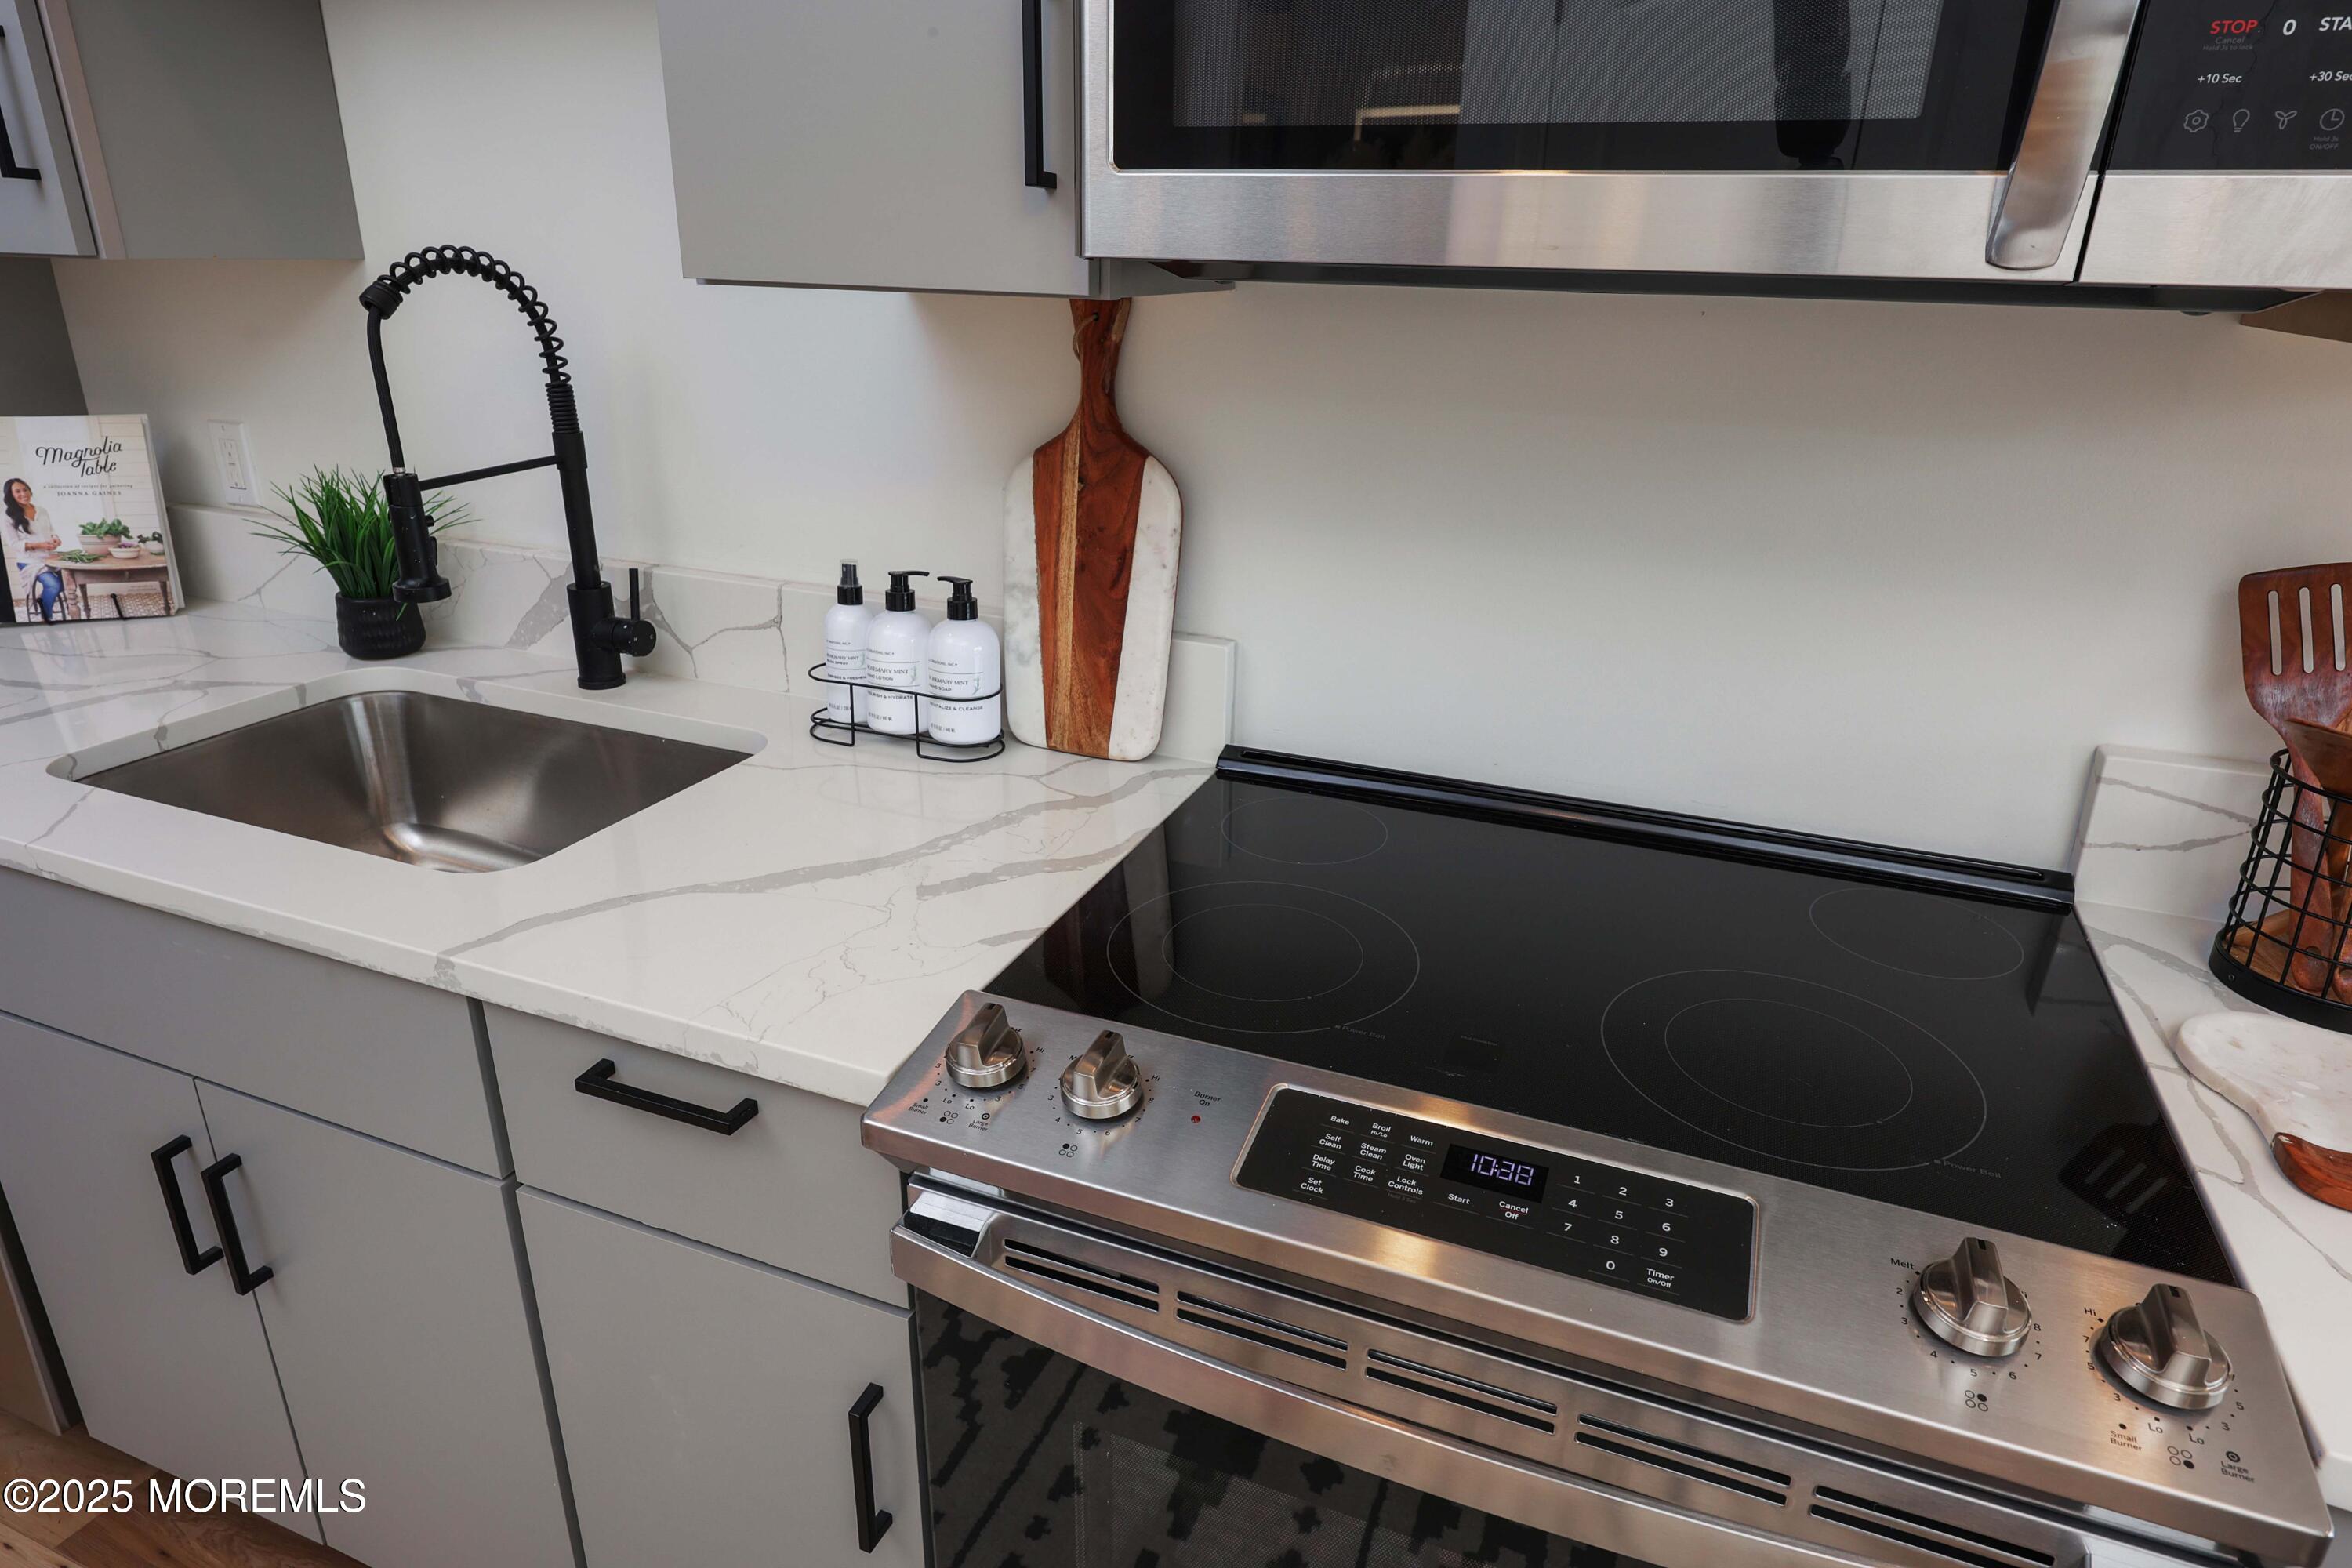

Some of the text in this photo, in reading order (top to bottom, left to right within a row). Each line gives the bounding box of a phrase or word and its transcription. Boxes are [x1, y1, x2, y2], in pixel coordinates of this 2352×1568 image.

[2209, 19, 2258, 34] STOP
[2282, 19, 2297, 36] 0
[2197, 73, 2242, 84] +10 Sec
[2309, 71, 2332, 82] +30
[35, 436, 123, 468] Magnolia
[81, 455, 117, 477] Table
[1194, 1091, 1221, 1102] Burner
[908, 1106, 928, 1115] Burner
[972, 1118, 989, 1127] Large
[1330, 1115, 1350, 1126] Bake
[968, 1123, 989, 1132] Burner
[1372, 1123, 1391, 1132] Broil
[1325, 1133, 1342, 1142] Self
[1410, 1135, 1433, 1146] Warm
[1319, 1138, 1342, 1149] Clean
[1360, 1143, 1387, 1154] Steam
[1312, 1154, 1336, 1165] Delay
[1359, 1149, 1383, 1160] Clean
[1405, 1154, 1426, 1164] Oven
[1312, 1160, 1331, 1171] Time
[1355, 1165, 1377, 1176] Cook
[1403, 1160, 1425, 1171] Light
[1471, 1154, 1534, 1186] 10:38
[1944, 1160, 2002, 1178] Power Boil
[1308, 1178, 1323, 1186] Set
[1353, 1171, 1374, 1182] Time
[1397, 1176, 1417, 1186] Lock
[1574, 1175, 1581, 1184] 1
[1301, 1183, 1323, 1194] Clock
[1388, 1181, 1424, 1196] Controls
[1618, 1187, 1628, 1196] 2
[1448, 1193, 1471, 1205] Start
[1568, 1200, 1577, 1208] 4
[1665, 1198, 1674, 1207] 3
[1499, 1201, 1529, 1214] Cancel
[1504, 1211, 1519, 1220] Off
[1614, 1210, 1624, 1220] 5
[1563, 1223, 1573, 1232] 7
[1662, 1223, 1671, 1232] 6
[1610, 1236, 1620, 1245] 8
[1659, 1247, 1668, 1258] 9
[1606, 1261, 1616, 1270] 0
[1890, 1258, 1915, 1270] Melt
[1646, 1267, 1675, 1281] Timer
[1647, 1277, 1671, 1288] On/Off
[2084, 1308, 2096, 1317] Hi
[1970, 1369, 1978, 1377] 5
[2114, 1393, 2122, 1402] 3
[2236, 1402, 2245, 1411] 5
[2148, 1423, 2164, 1434] Lo
[2222, 1422, 2230, 1432] 3
[2111, 1430, 2137, 1443] Small
[2189, 1433, 2205, 1446] Lo
[2110, 1437, 2143, 1451] Burner
[2220, 1460, 2249, 1474] Large
[2221, 1468, 2256, 1483] Burner
